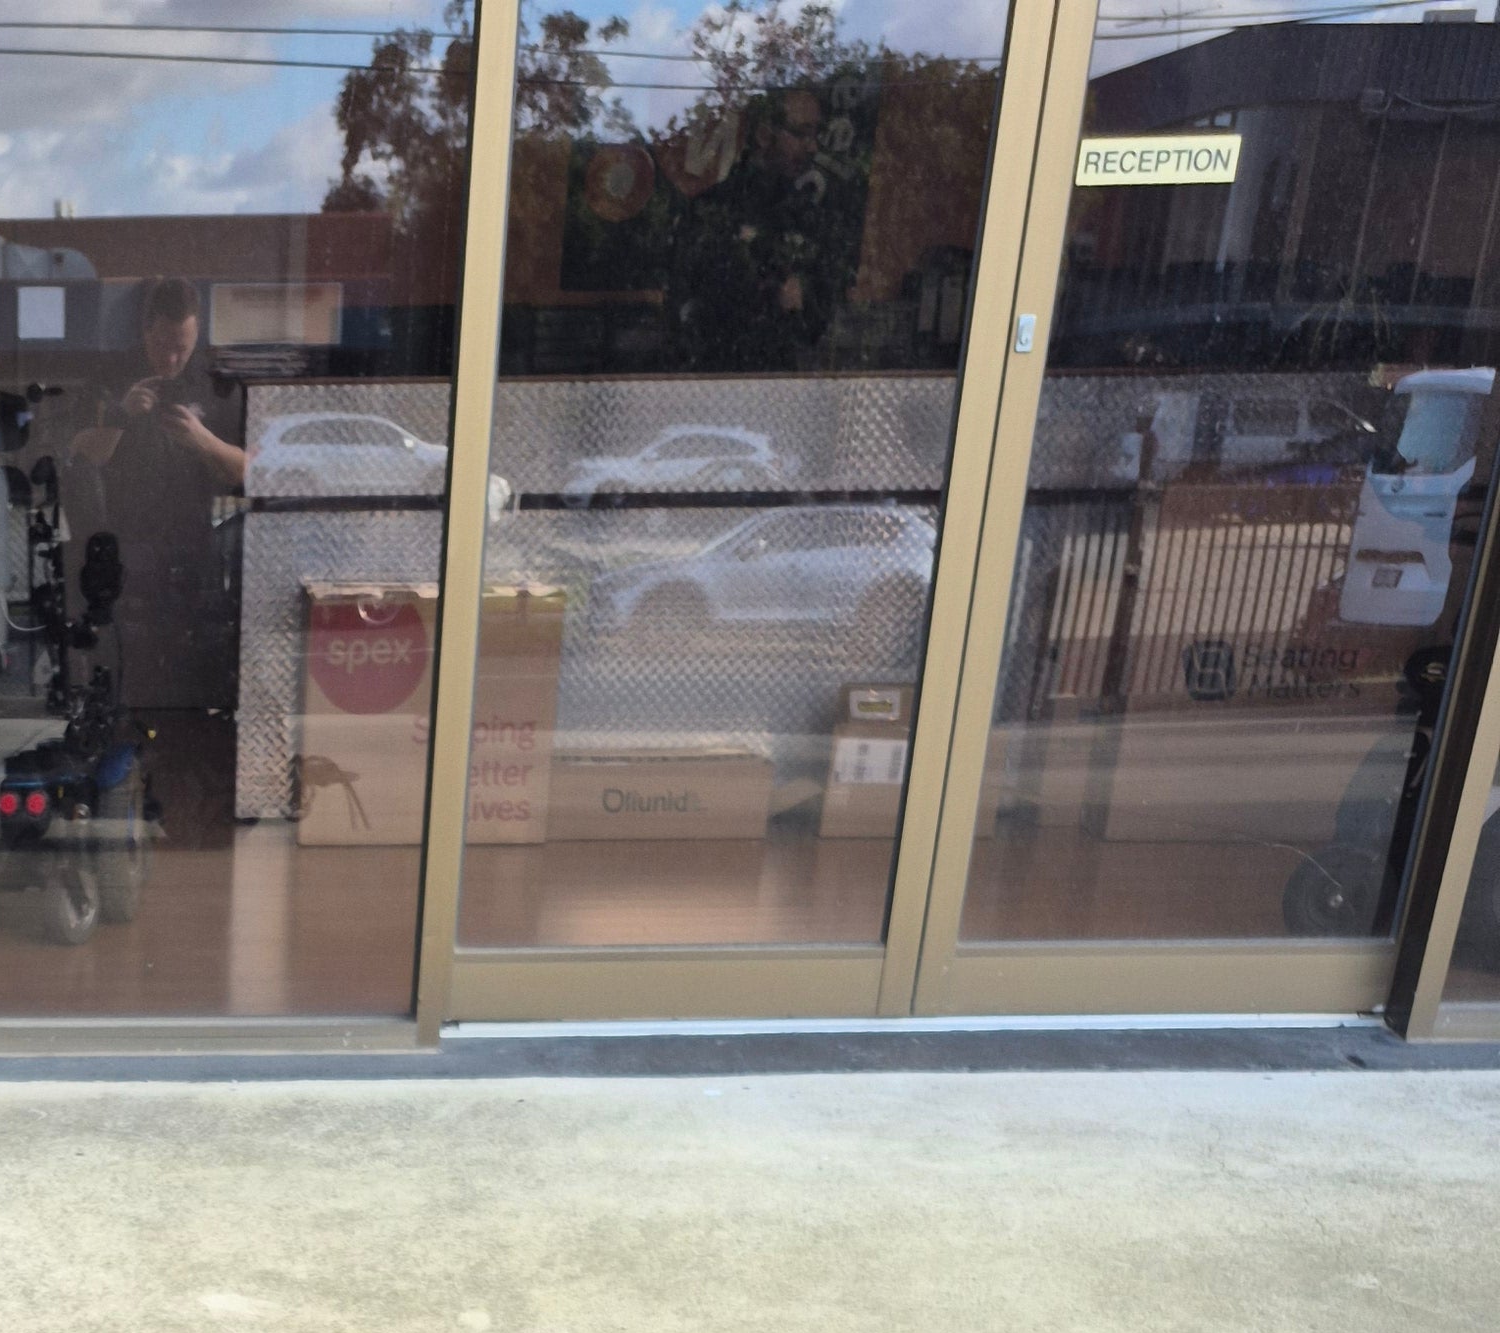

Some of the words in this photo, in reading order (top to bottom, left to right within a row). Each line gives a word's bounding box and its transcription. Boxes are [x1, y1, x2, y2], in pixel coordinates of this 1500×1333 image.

[1084, 149, 1231, 174] RECEPTION
[325, 637, 414, 674] spex
[468, 793, 531, 823] ives
